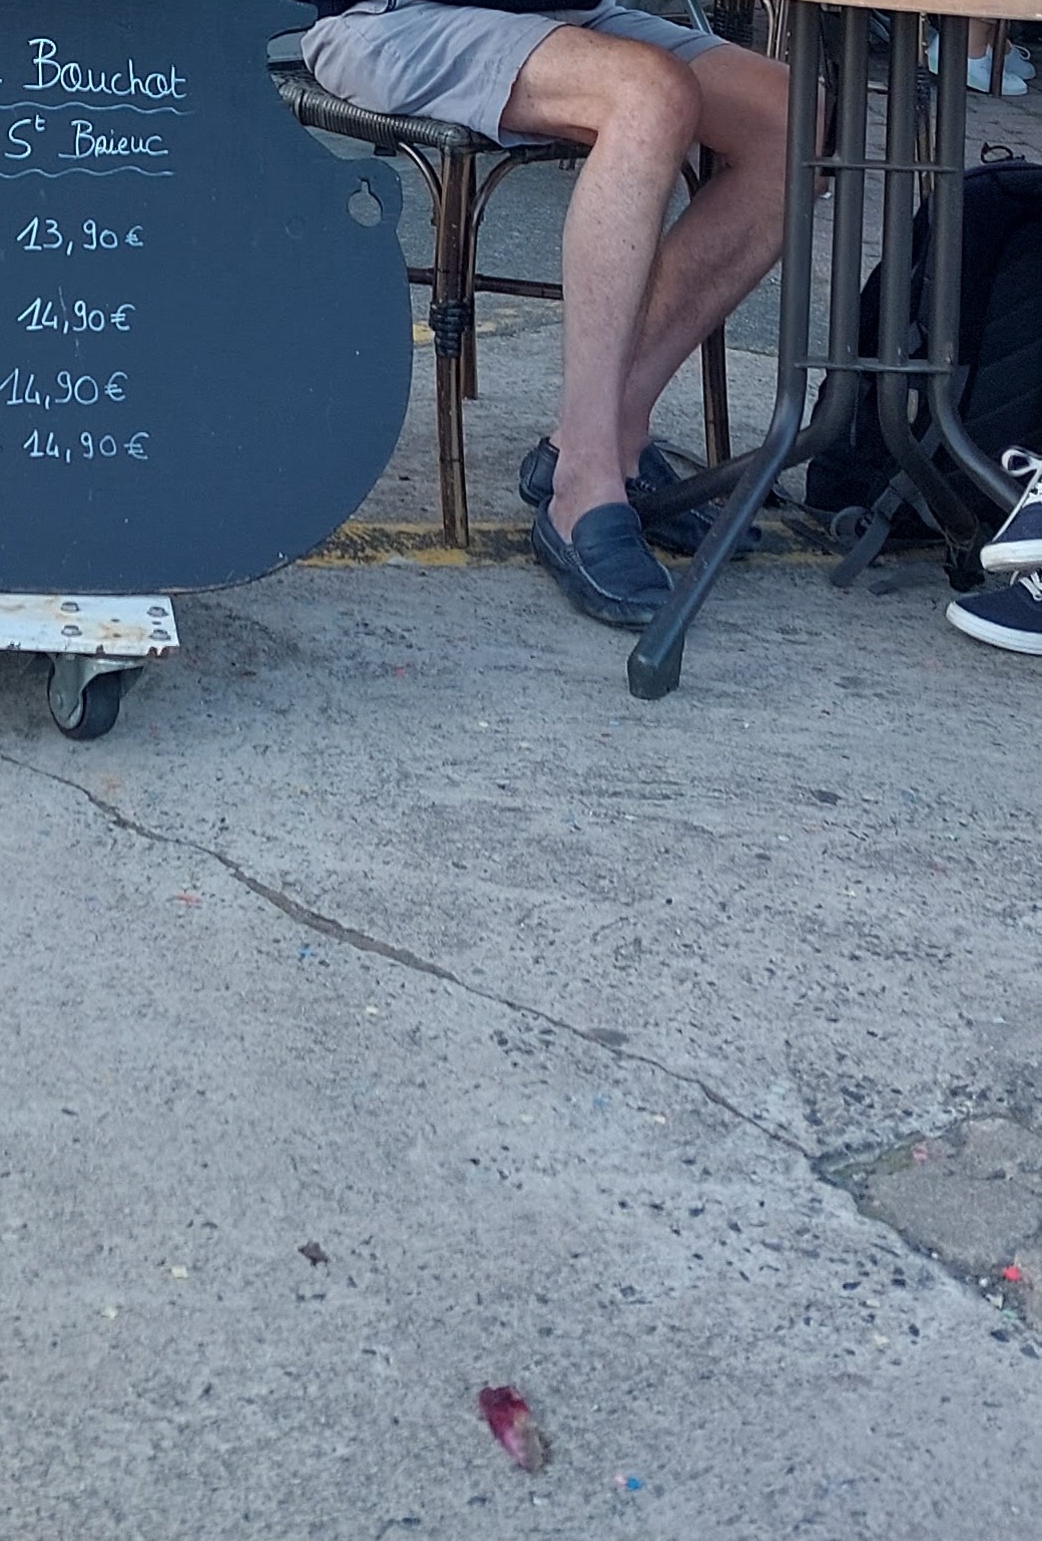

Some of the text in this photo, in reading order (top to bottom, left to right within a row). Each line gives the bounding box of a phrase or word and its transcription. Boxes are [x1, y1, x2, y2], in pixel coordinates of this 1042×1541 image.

[25, 38, 188, 98] Bouchot
[60, 119, 170, 158] Brieuc
[15, 217, 145, 258] 13,90€
[17, 298, 133, 334] 14,90€
[0, 372, 129, 410] 14,90€
[23, 428, 150, 464] 14,90€
